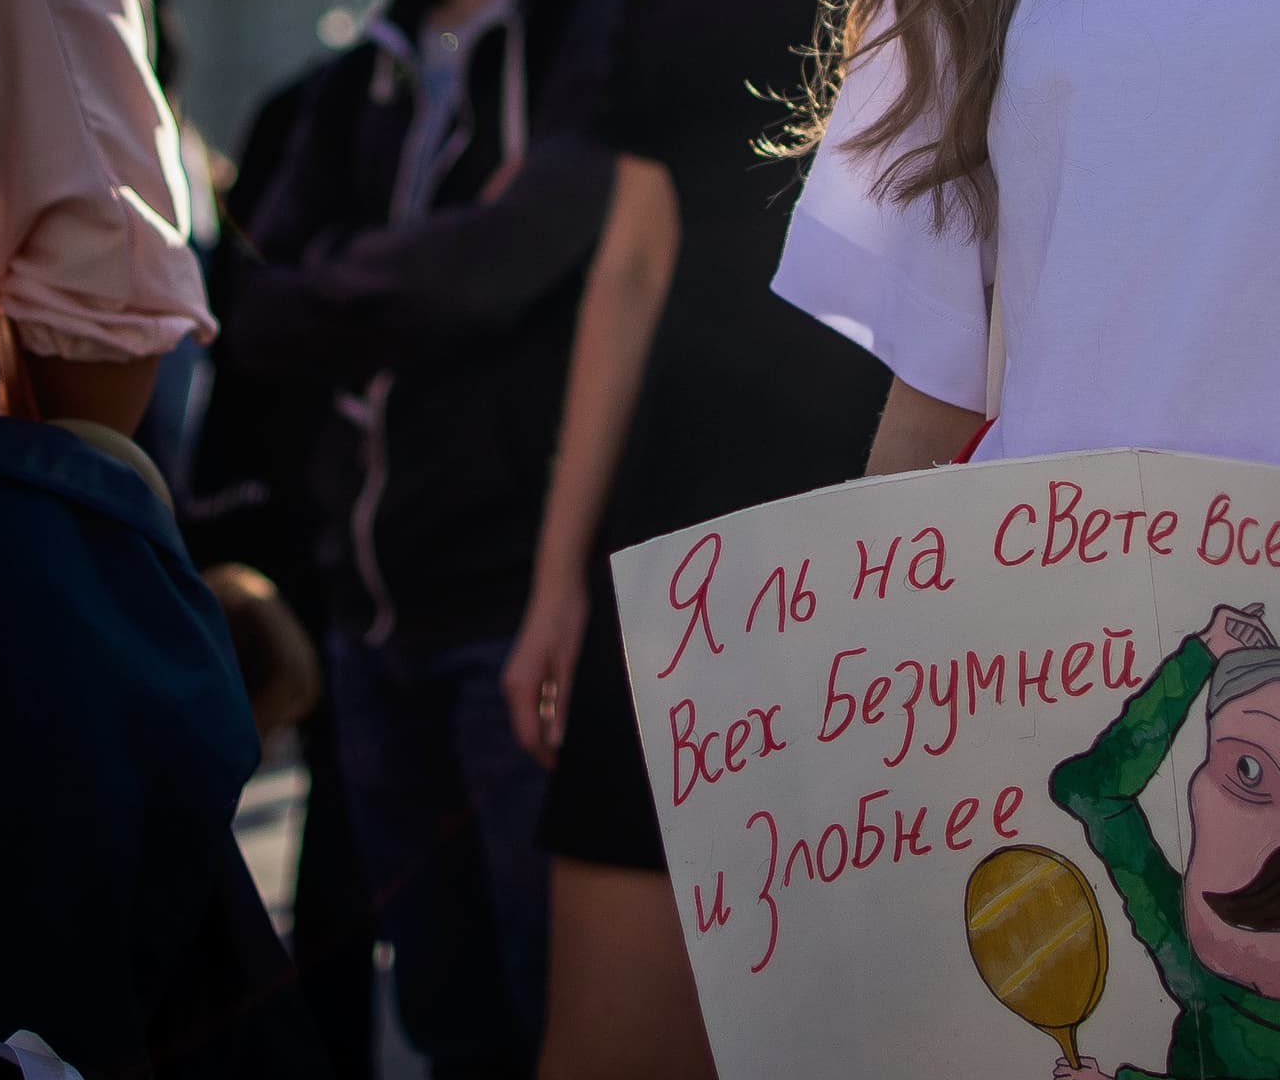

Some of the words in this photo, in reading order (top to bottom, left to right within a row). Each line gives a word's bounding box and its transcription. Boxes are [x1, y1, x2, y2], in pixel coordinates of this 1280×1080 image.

[656, 532, 725, 680] Я
[744, 558, 817, 633] ль
[669, 698, 787, 807] Всех
[694, 870, 732, 933] и
